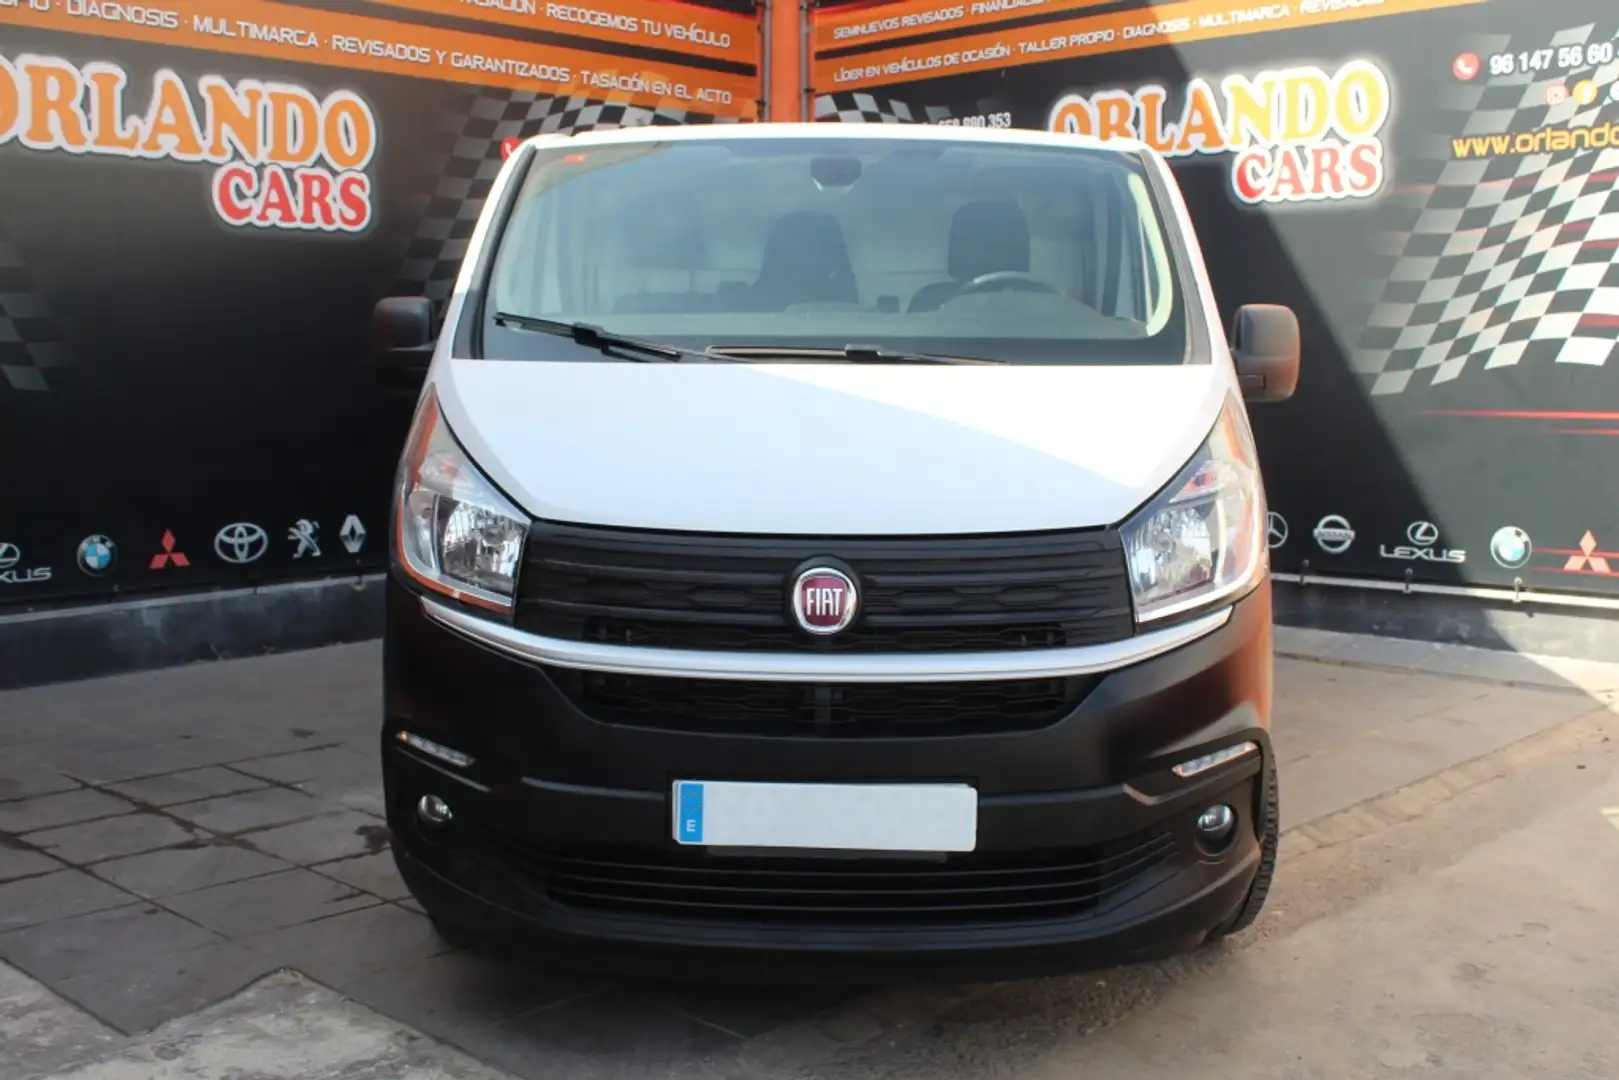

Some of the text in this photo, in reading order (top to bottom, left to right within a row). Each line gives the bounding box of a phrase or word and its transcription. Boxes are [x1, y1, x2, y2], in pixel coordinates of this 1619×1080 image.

[546, 3, 638, 32] RECOGEMOS
[642, 20, 661, 35] TU
[664, 23, 731, 48] VEHÍCULO
[901, 6, 965, 28] REVISADOS
[67, 0, 179, 29] DIAGNOSIS
[193, 15, 319, 48] MULTIMARCA
[332, 35, 432, 63] REVISADOS
[435, 50, 448, 65] Y
[451, 52, 571, 82] GARANTIZADOS
[580, 70, 650, 93] TASACIÓN
[651, 80, 672, 95] EN
[674, 84, 692, 99] EL
[696, 88, 732, 104] ACTO
[833, 68, 863, 82] LÍDER
[866, 66, 881, 77] EN
[882, 56, 942, 75] VEHÍCULOS
[943, 53, 960, 66] DE
[961, 42, 1011, 62] OCASIÓN
[1019, 37, 1067, 54] TALLER
[1069, 30, 1115, 47] PROPIO
[1490, 42, 1613, 75] 96 147 56 60
[1233, 137, 1382, 201] CARS
[214, 165, 370, 230] CARS
[1380, 544, 1466, 564] LEXUS
[806, 588, 843, 616] FIAT
[686, 819, 697, 832] E
